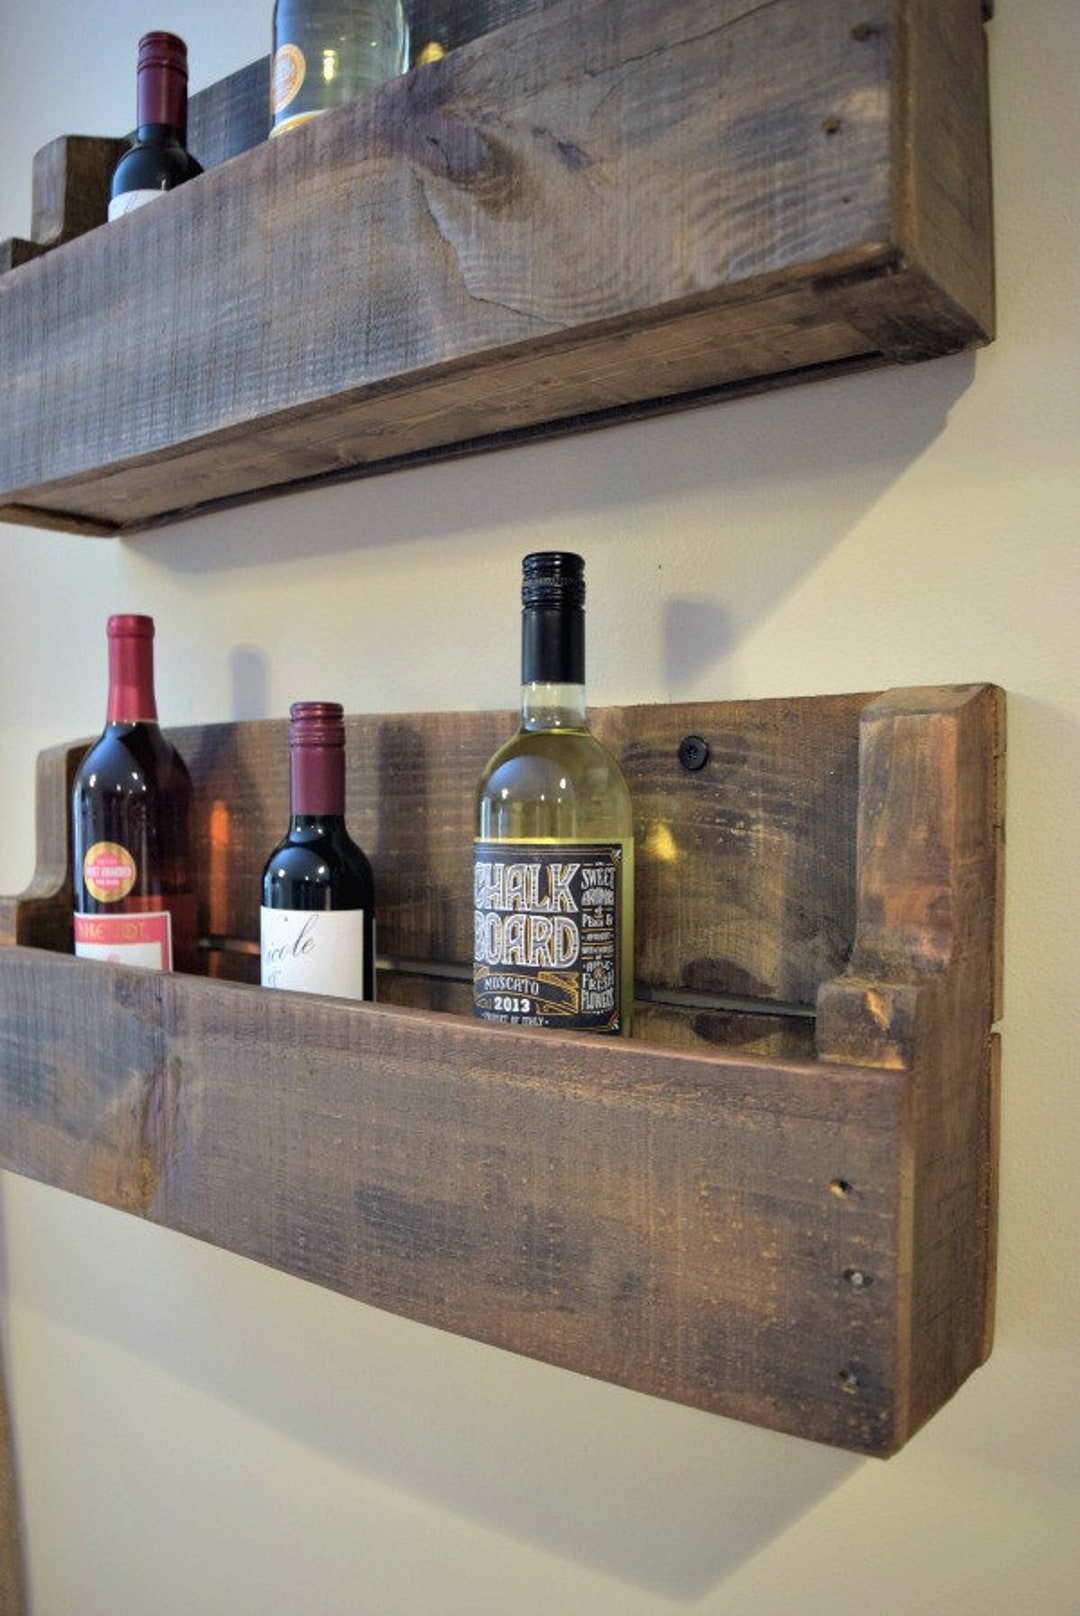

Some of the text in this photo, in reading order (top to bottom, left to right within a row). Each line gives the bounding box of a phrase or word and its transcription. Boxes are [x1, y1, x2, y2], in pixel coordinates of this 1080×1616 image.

[581, 868, 615, 890] SWEET
[485, 977, 539, 995] MOSCATO
[494, 996, 531, 1013] 2013
